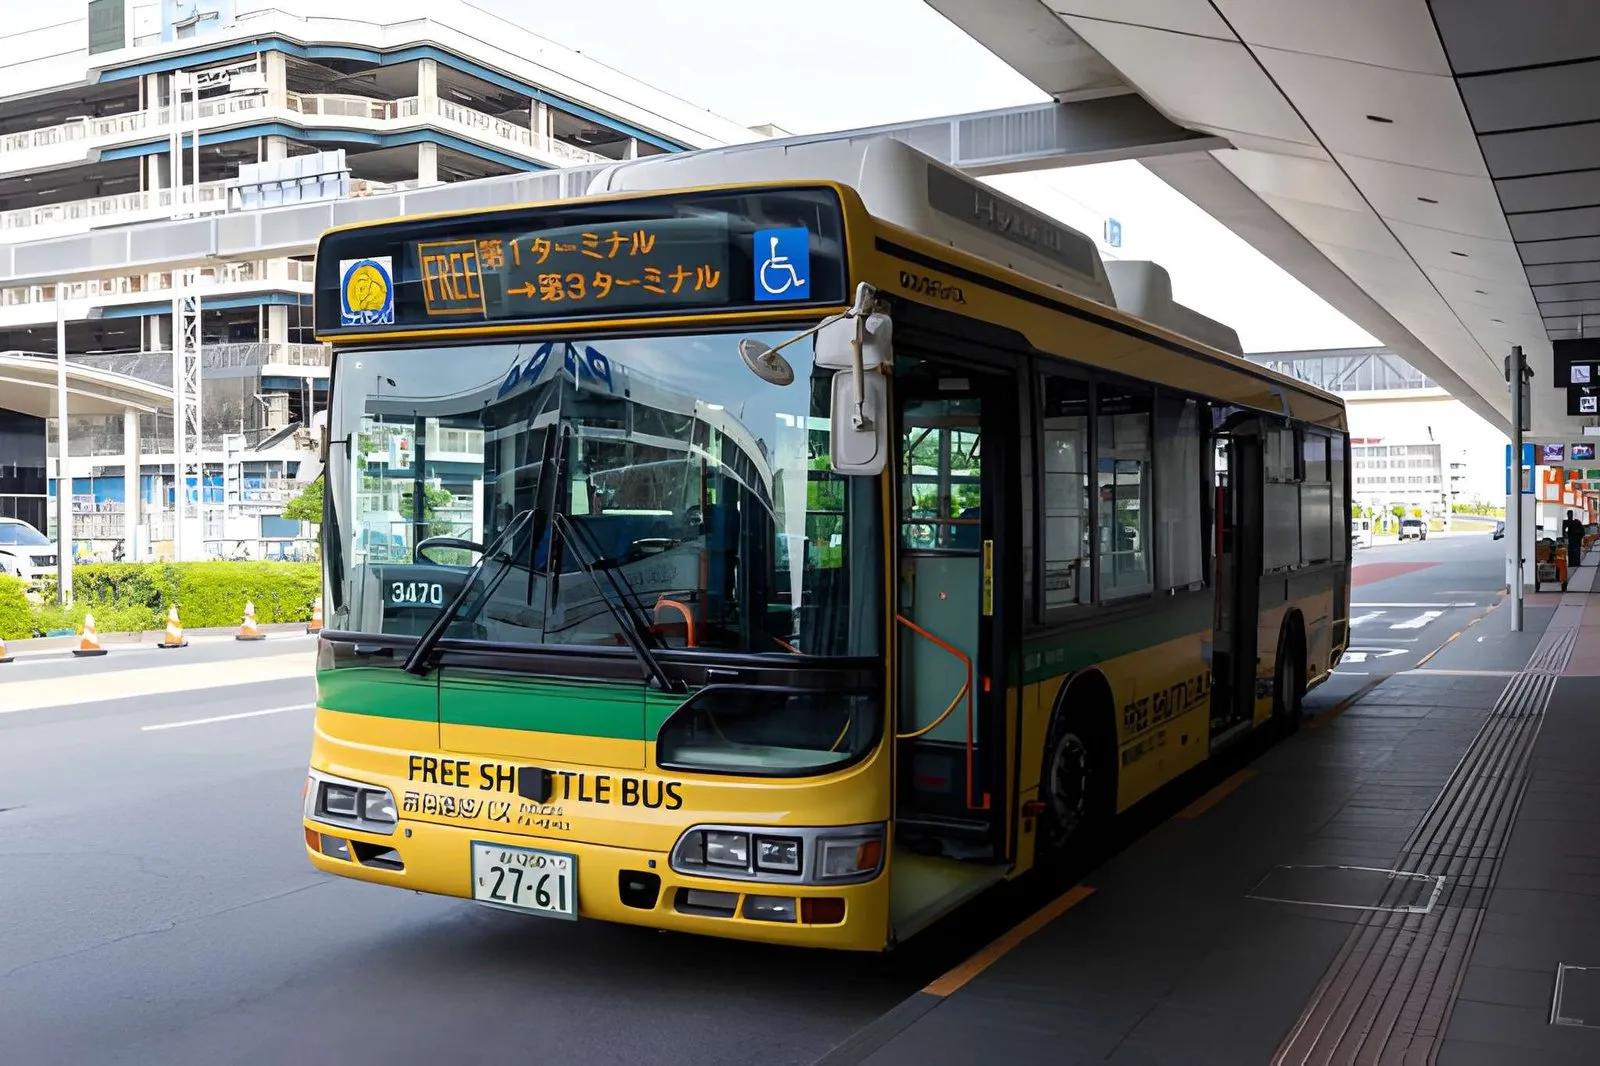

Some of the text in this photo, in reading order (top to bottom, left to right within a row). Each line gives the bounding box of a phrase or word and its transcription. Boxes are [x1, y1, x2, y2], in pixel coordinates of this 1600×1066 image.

[421, 252, 481, 301] FREE
[391, 582, 443, 604] 3470
[409, 755, 684, 811] FREE SHTLE BUS
